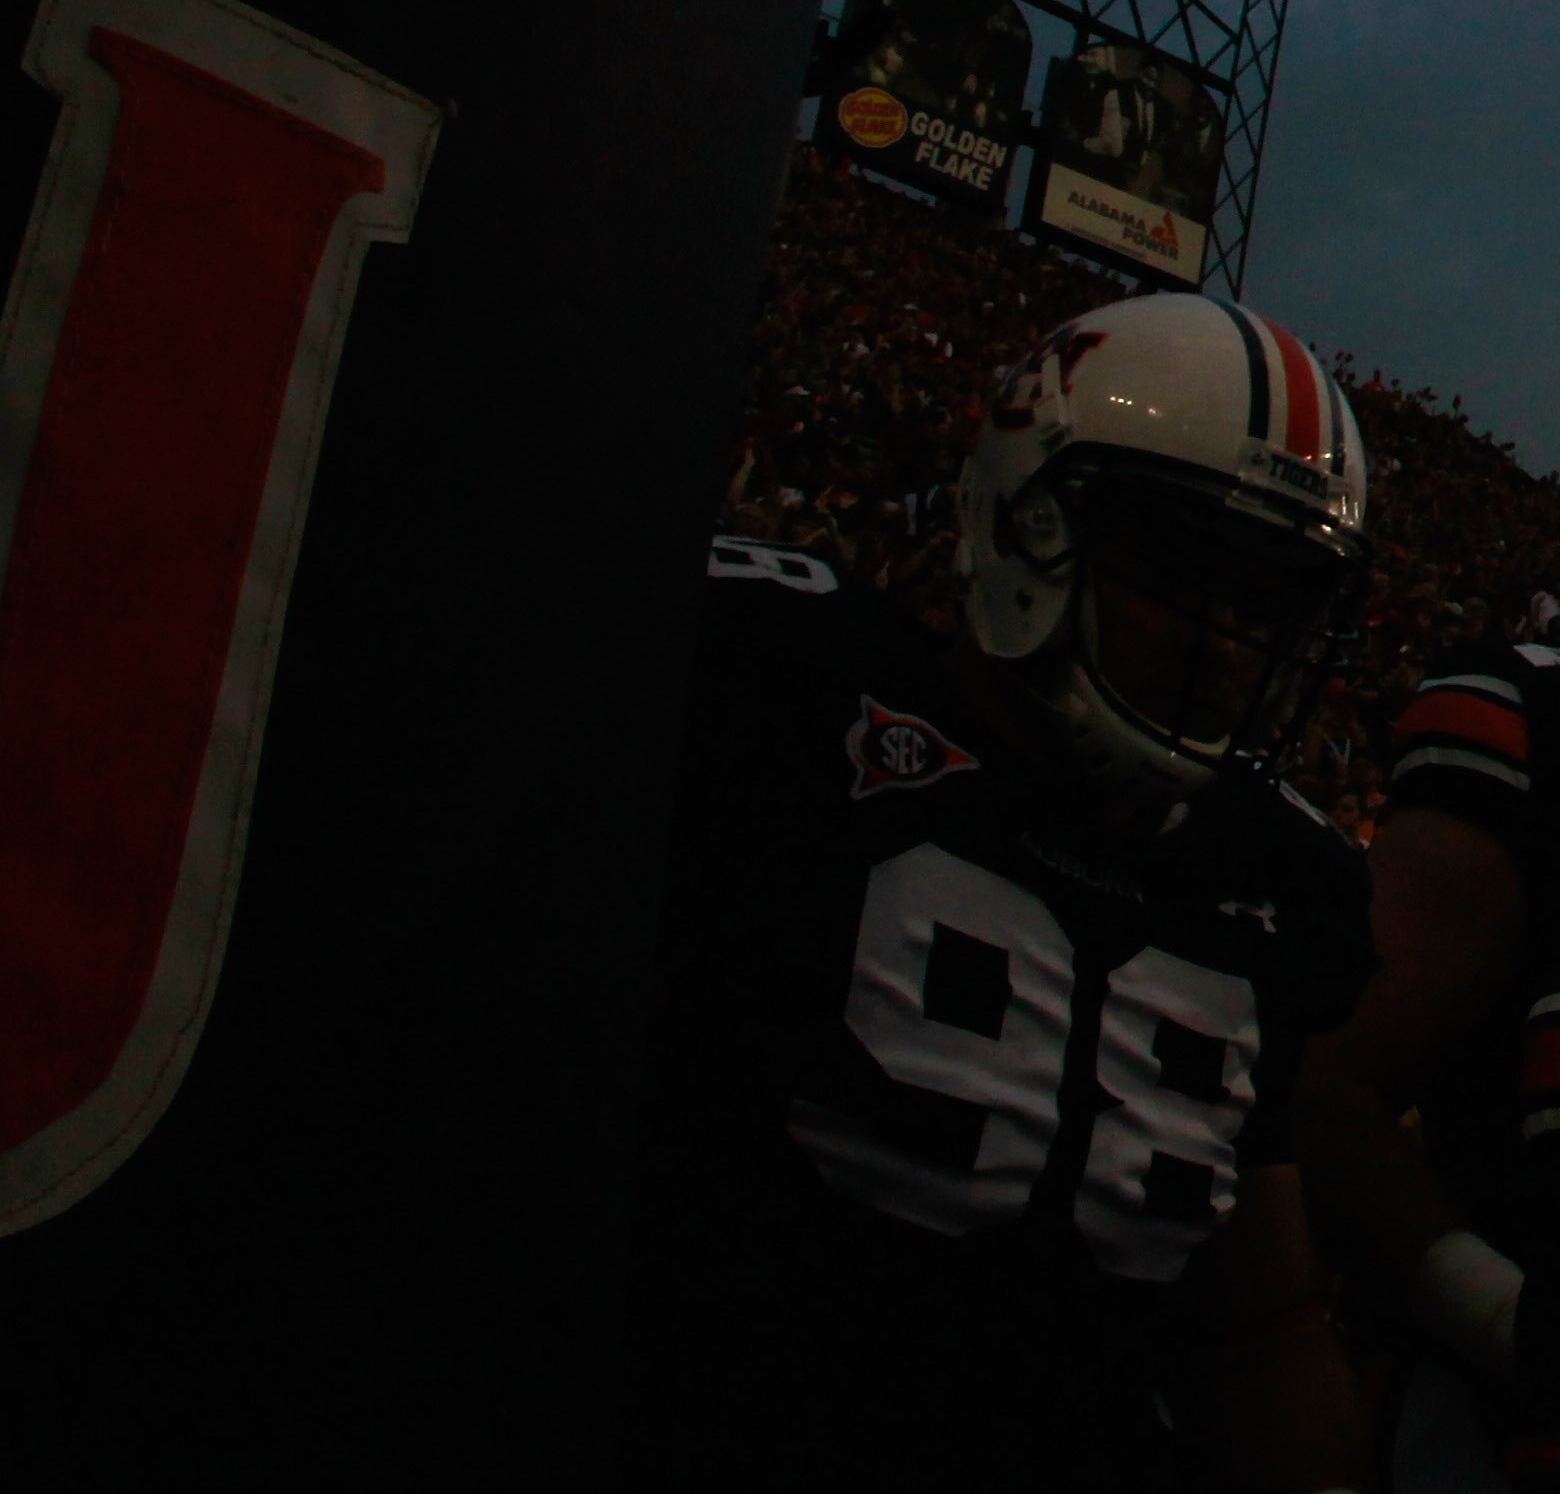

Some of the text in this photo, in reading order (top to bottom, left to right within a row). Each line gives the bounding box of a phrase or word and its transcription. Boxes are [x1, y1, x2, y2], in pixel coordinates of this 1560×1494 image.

[910, 111, 1008, 169] GOLDEN
[913, 140, 994, 192] FLAKE
[1067, 190, 1147, 233] ALABAMA
[1121, 226, 1179, 260] POWER
[1270, 453, 1328, 500] TIGERS
[881, 725, 928, 775] SEC
[786, 842, 1262, 1283] 98
